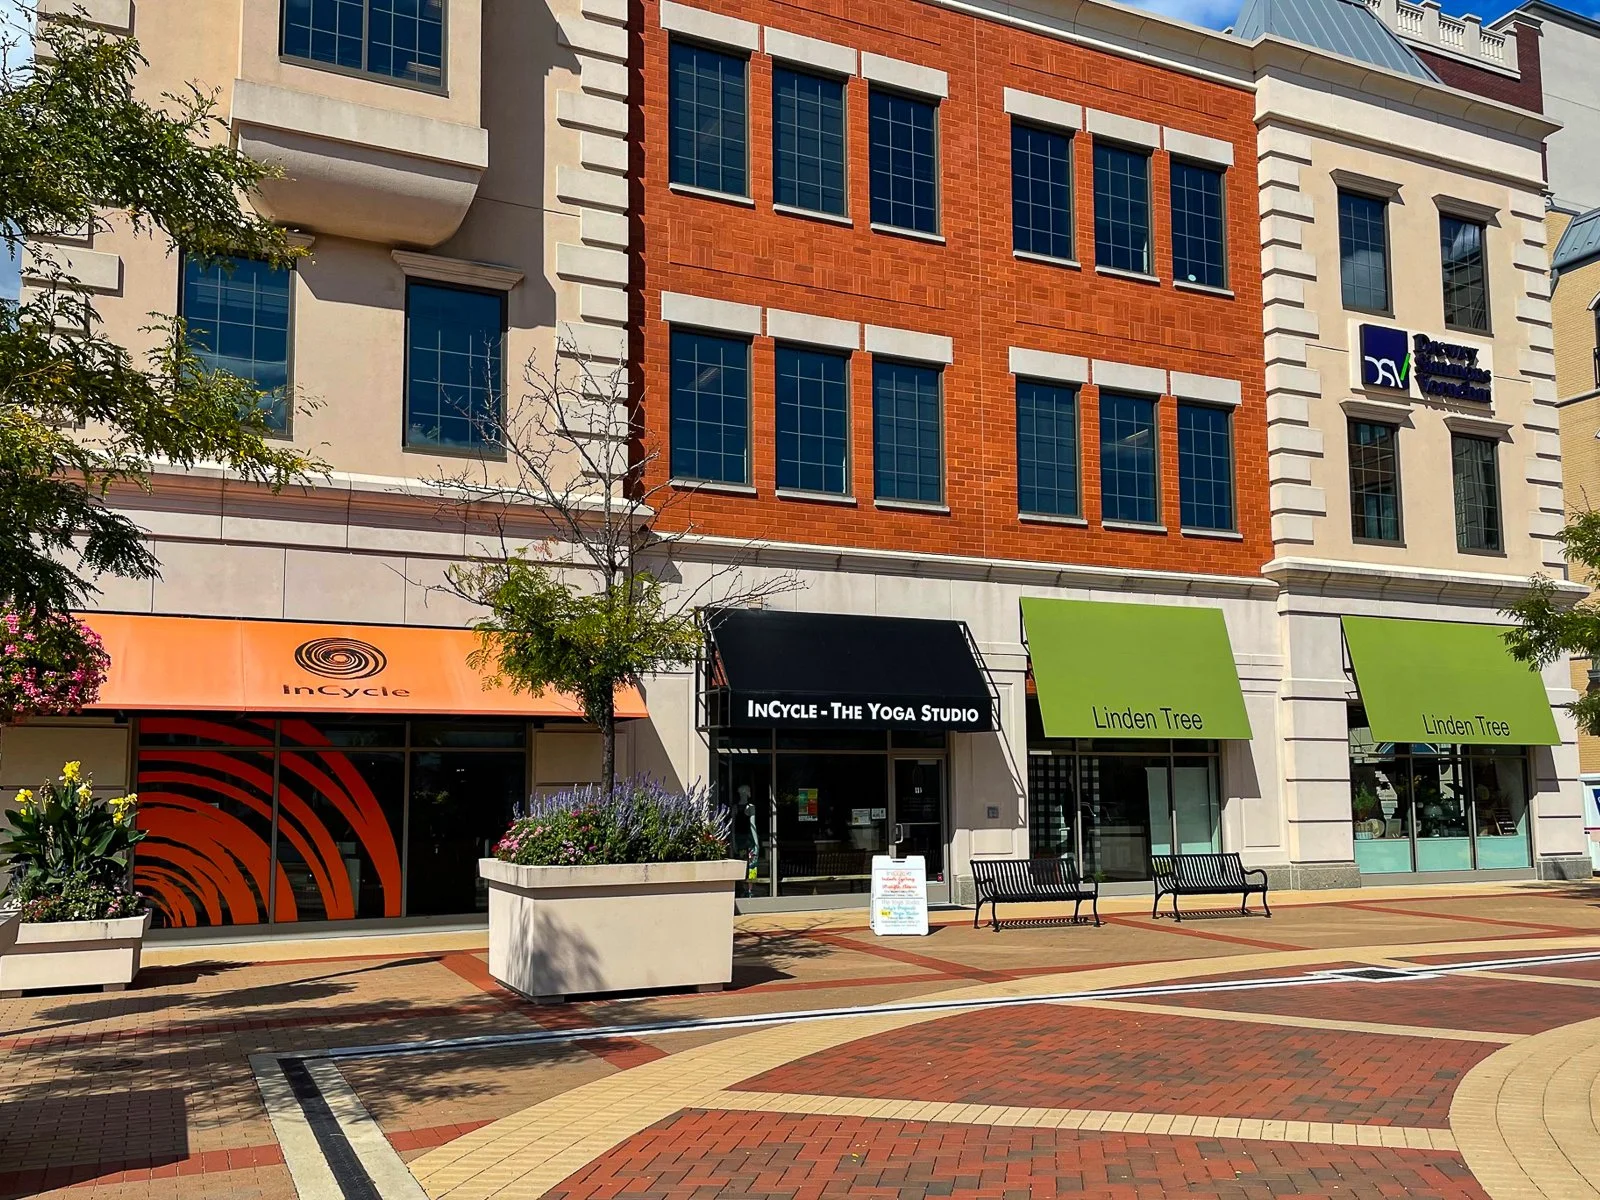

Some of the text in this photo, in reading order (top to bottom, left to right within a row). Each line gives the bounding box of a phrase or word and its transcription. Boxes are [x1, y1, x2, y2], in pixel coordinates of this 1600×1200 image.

[1364, 352, 1411, 389] DSV
[282, 684, 411, 699] InCycle
[747, 700, 818, 719] INCYCLE
[830, 702, 863, 720] THE
[867, 702, 917, 721] YOGA
[921, 704, 979, 722] STUDIO
[1092, 706, 1203, 730] Linden Tree
[1422, 714, 1511, 737] Linden Tree
